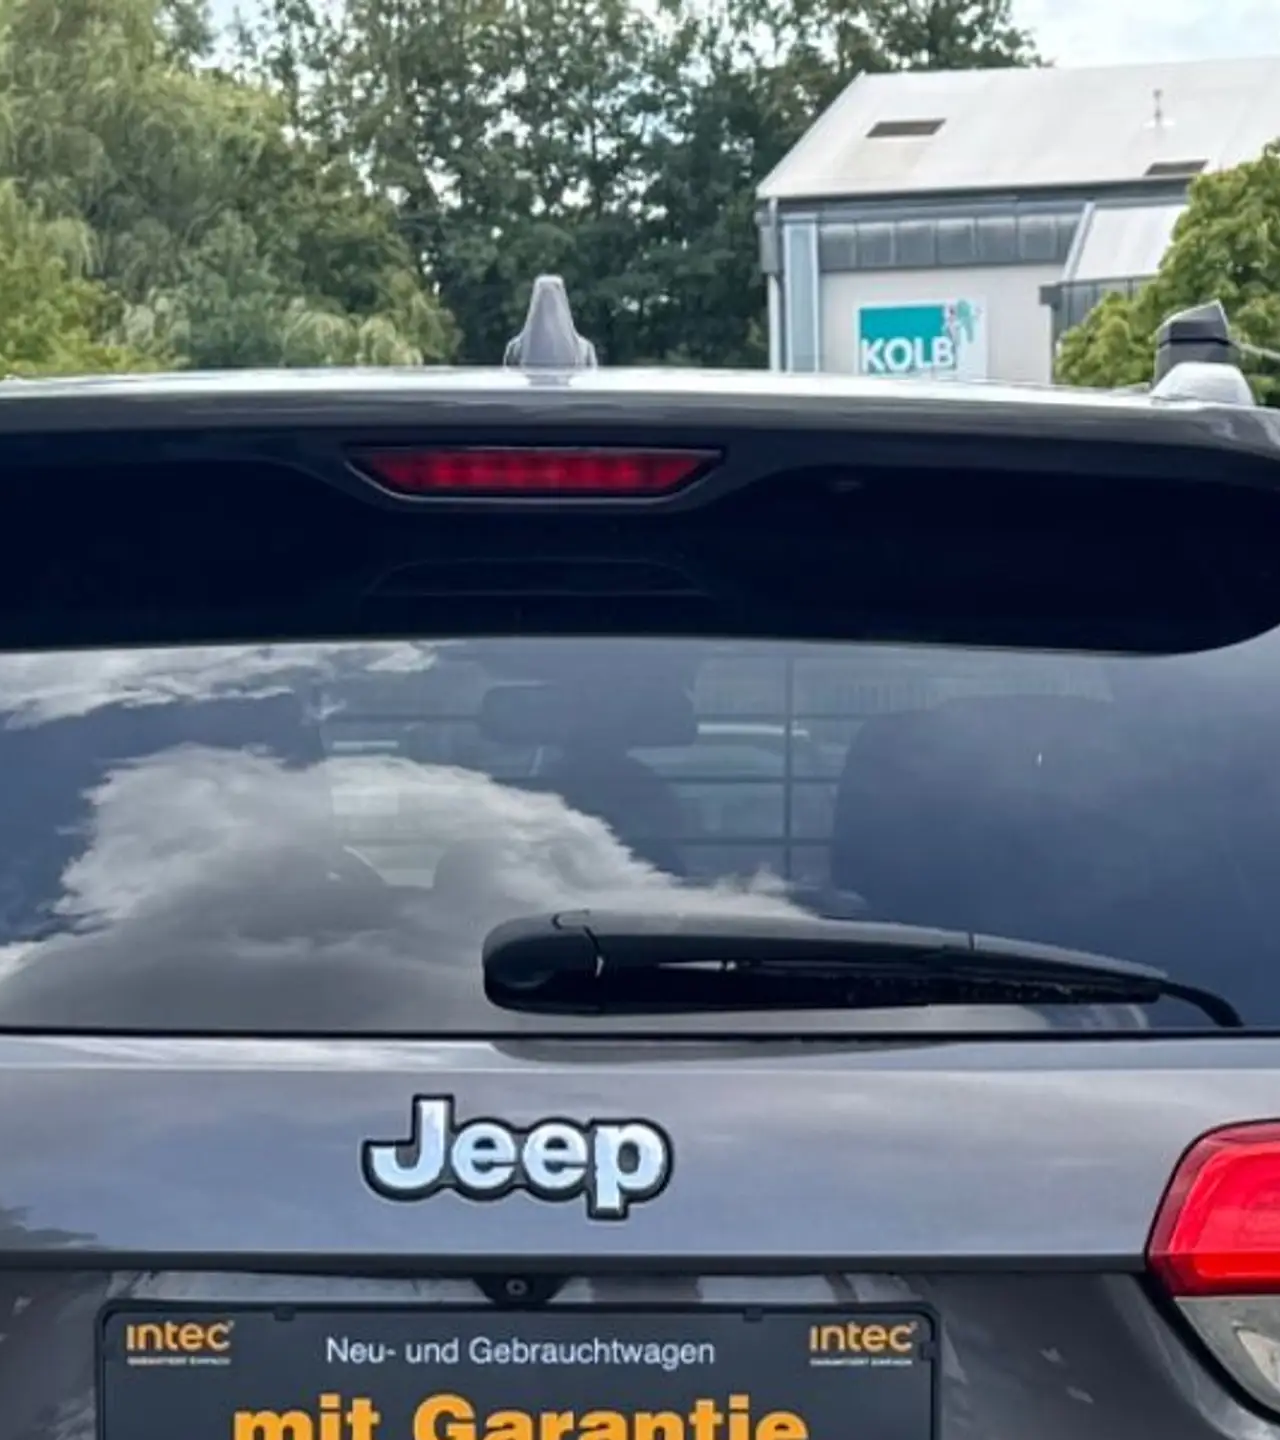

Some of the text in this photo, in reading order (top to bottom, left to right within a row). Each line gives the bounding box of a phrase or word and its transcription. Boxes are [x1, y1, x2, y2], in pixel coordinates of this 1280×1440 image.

[860, 335, 955, 373] KOLB
[362, 1094, 674, 1221] Jeep
[125, 1320, 234, 1352] intec
[326, 1336, 716, 1370] Neu- und Gebrauchtwagen
[809, 1321, 916, 1352] intec
